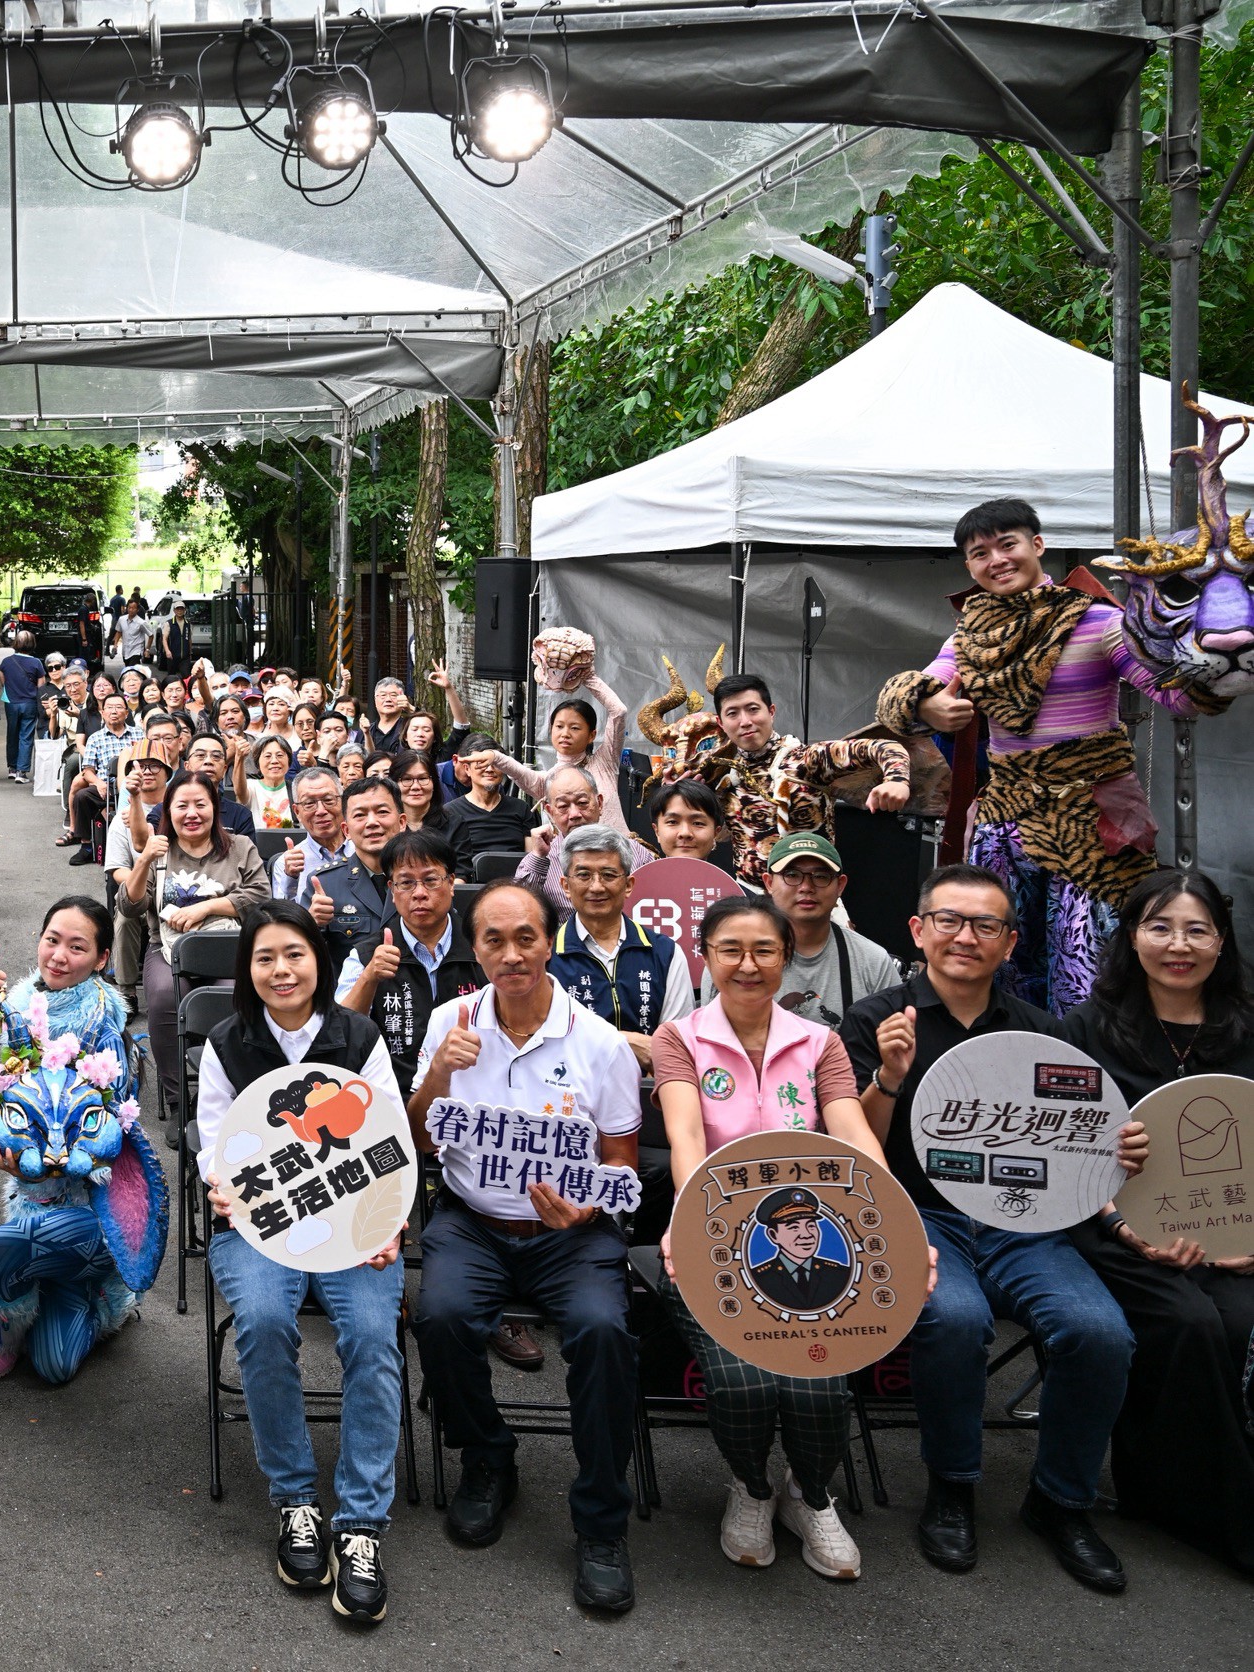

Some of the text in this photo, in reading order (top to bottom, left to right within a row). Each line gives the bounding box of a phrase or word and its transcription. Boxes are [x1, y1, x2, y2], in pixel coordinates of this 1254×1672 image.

[383, 992, 404, 1056] 林肇雄
[638, 969, 652, 1035] 桃園市榮民
[432, 1103, 592, 1160] 眷村記憶
[231, 1125, 351, 1204] 太武人
[477, 1153, 635, 1209] 世代傳承
[1154, 1183, 1247, 1215] 太武藝
[1160, 1219, 1201, 1234] Taiwu
[1206, 1216, 1227, 1228] Art
[862, 1211, 893, 1305] 忠貞堅定
[743, 1325, 887, 1341] GENERAL'S CANTEEN
